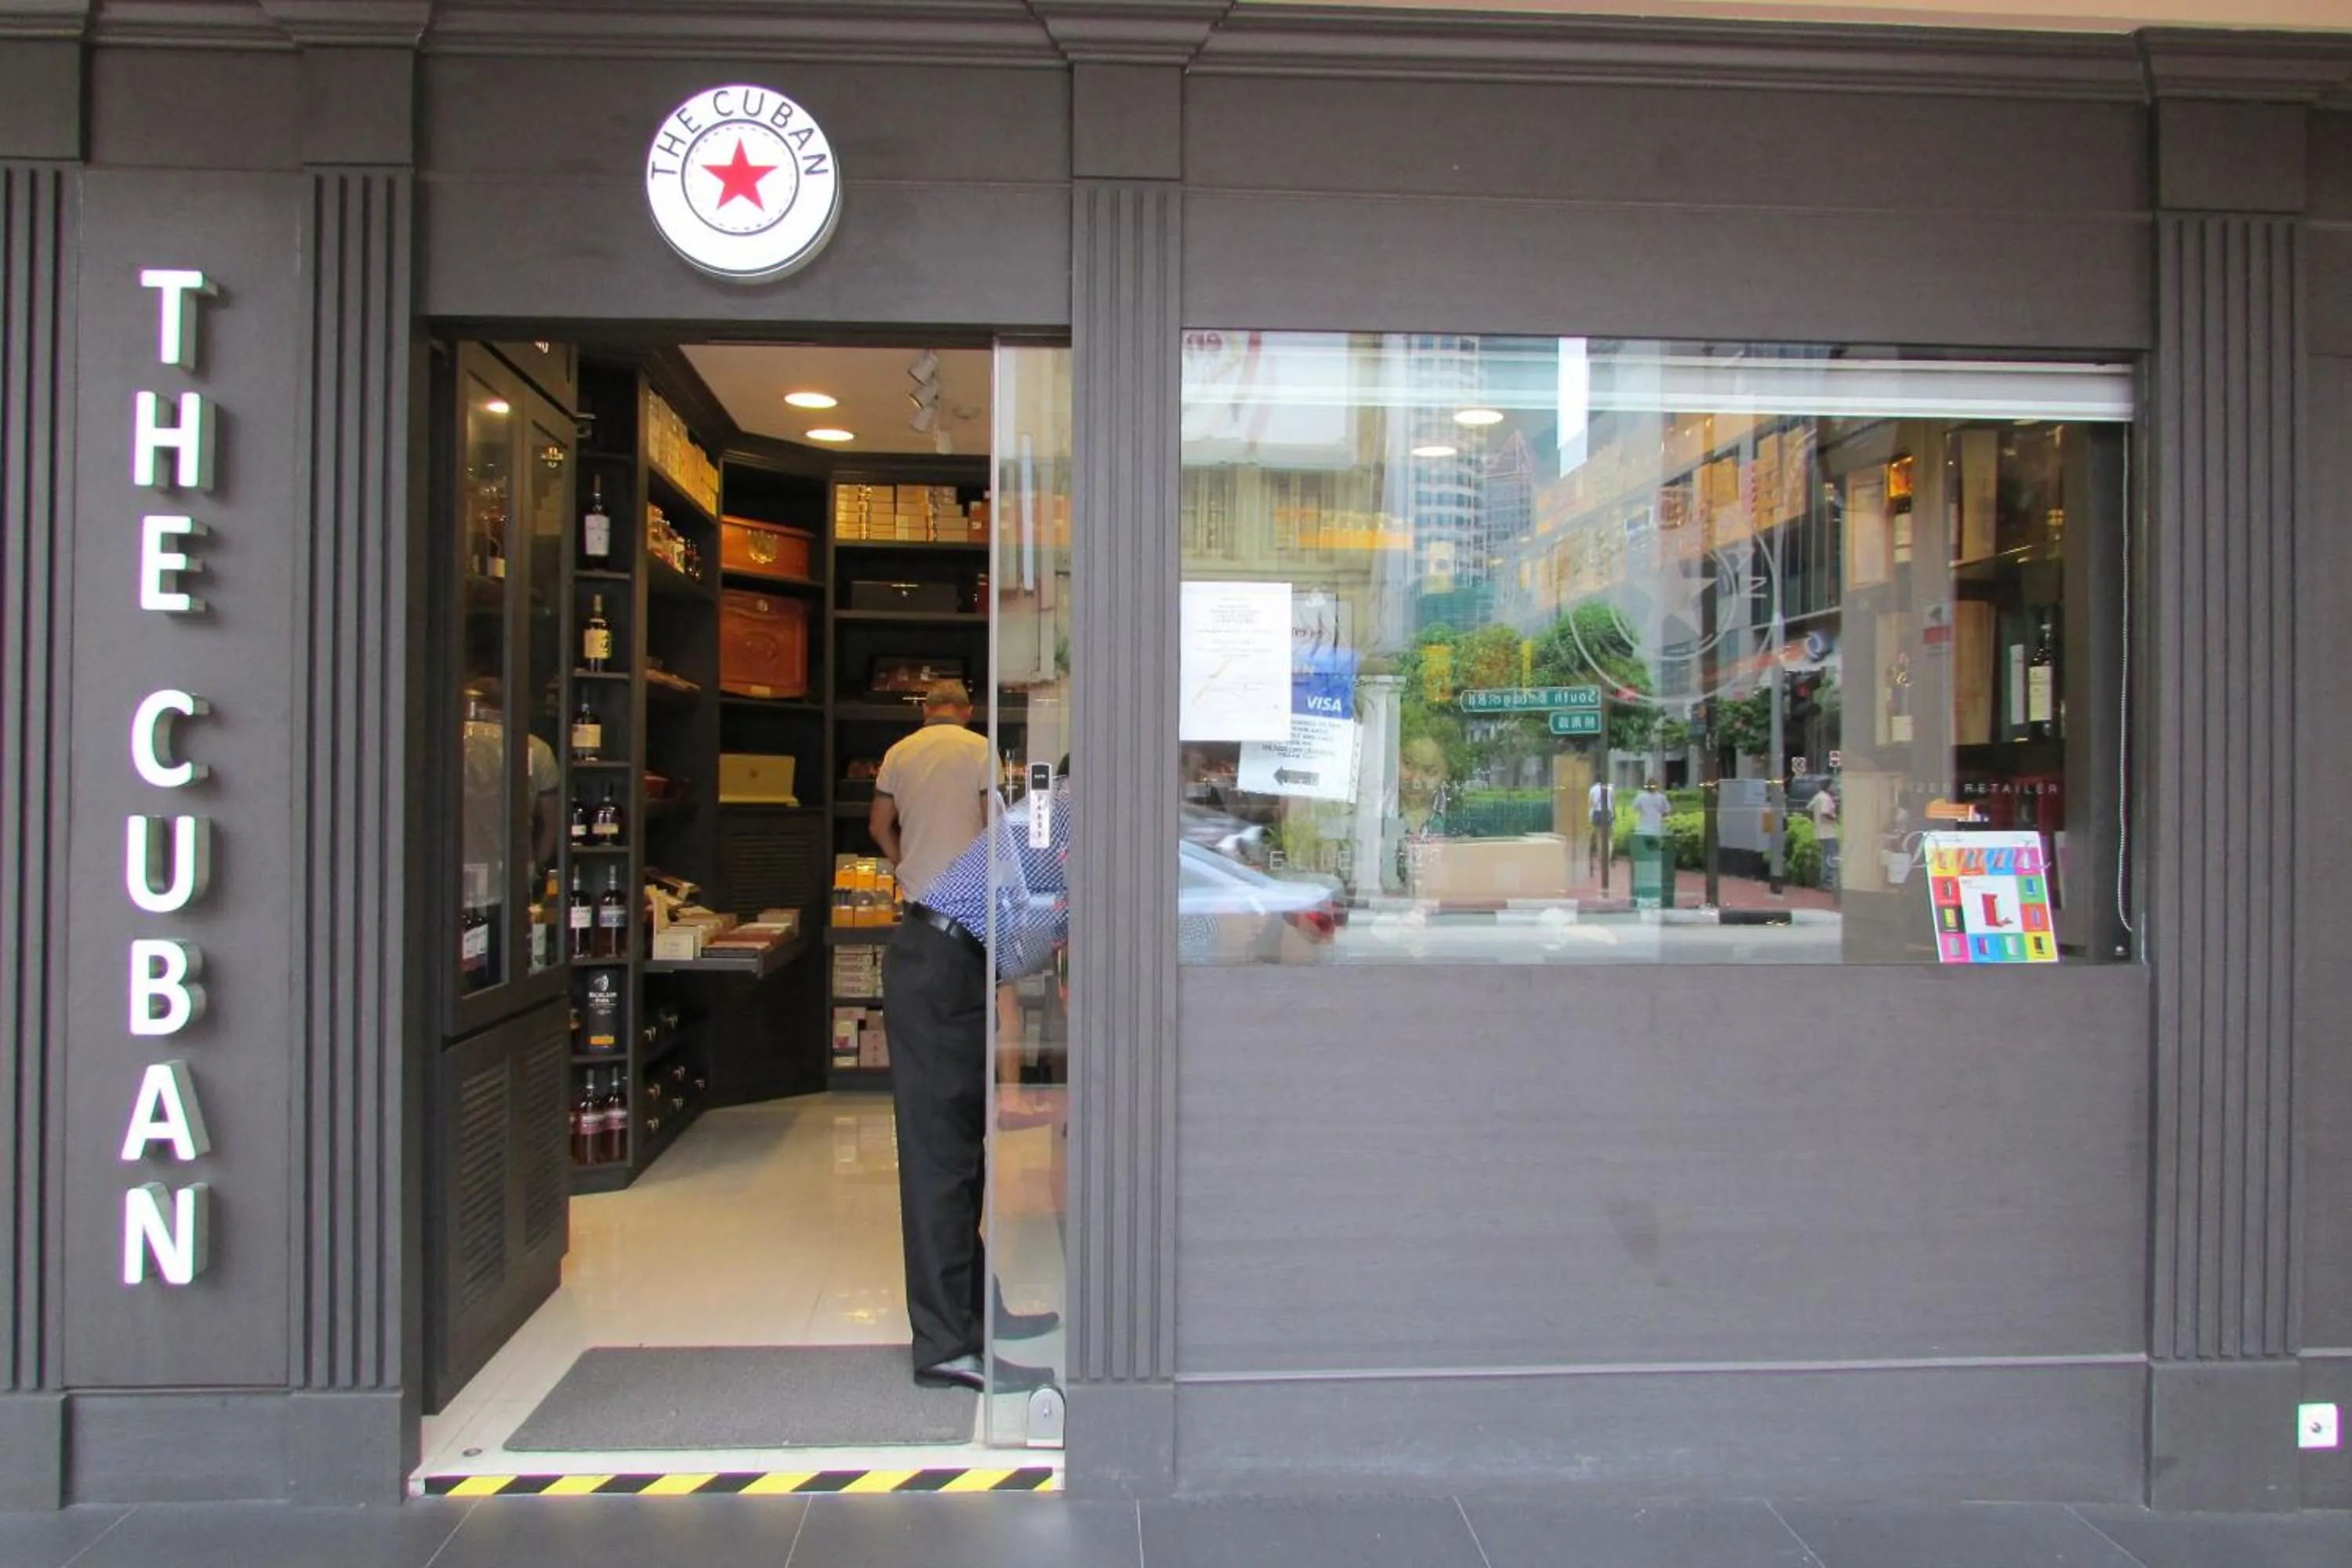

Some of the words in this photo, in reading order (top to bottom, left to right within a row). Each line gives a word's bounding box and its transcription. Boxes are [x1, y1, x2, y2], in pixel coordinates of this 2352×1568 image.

[652, 107, 702, 180] THE
[713, 89, 829, 176] CUBAN
[134, 270, 204, 611] THE
[1306, 695, 1342, 713] VISA
[1964, 782, 2058, 795] RETAILER
[122, 689, 198, 1285] CUBAN
